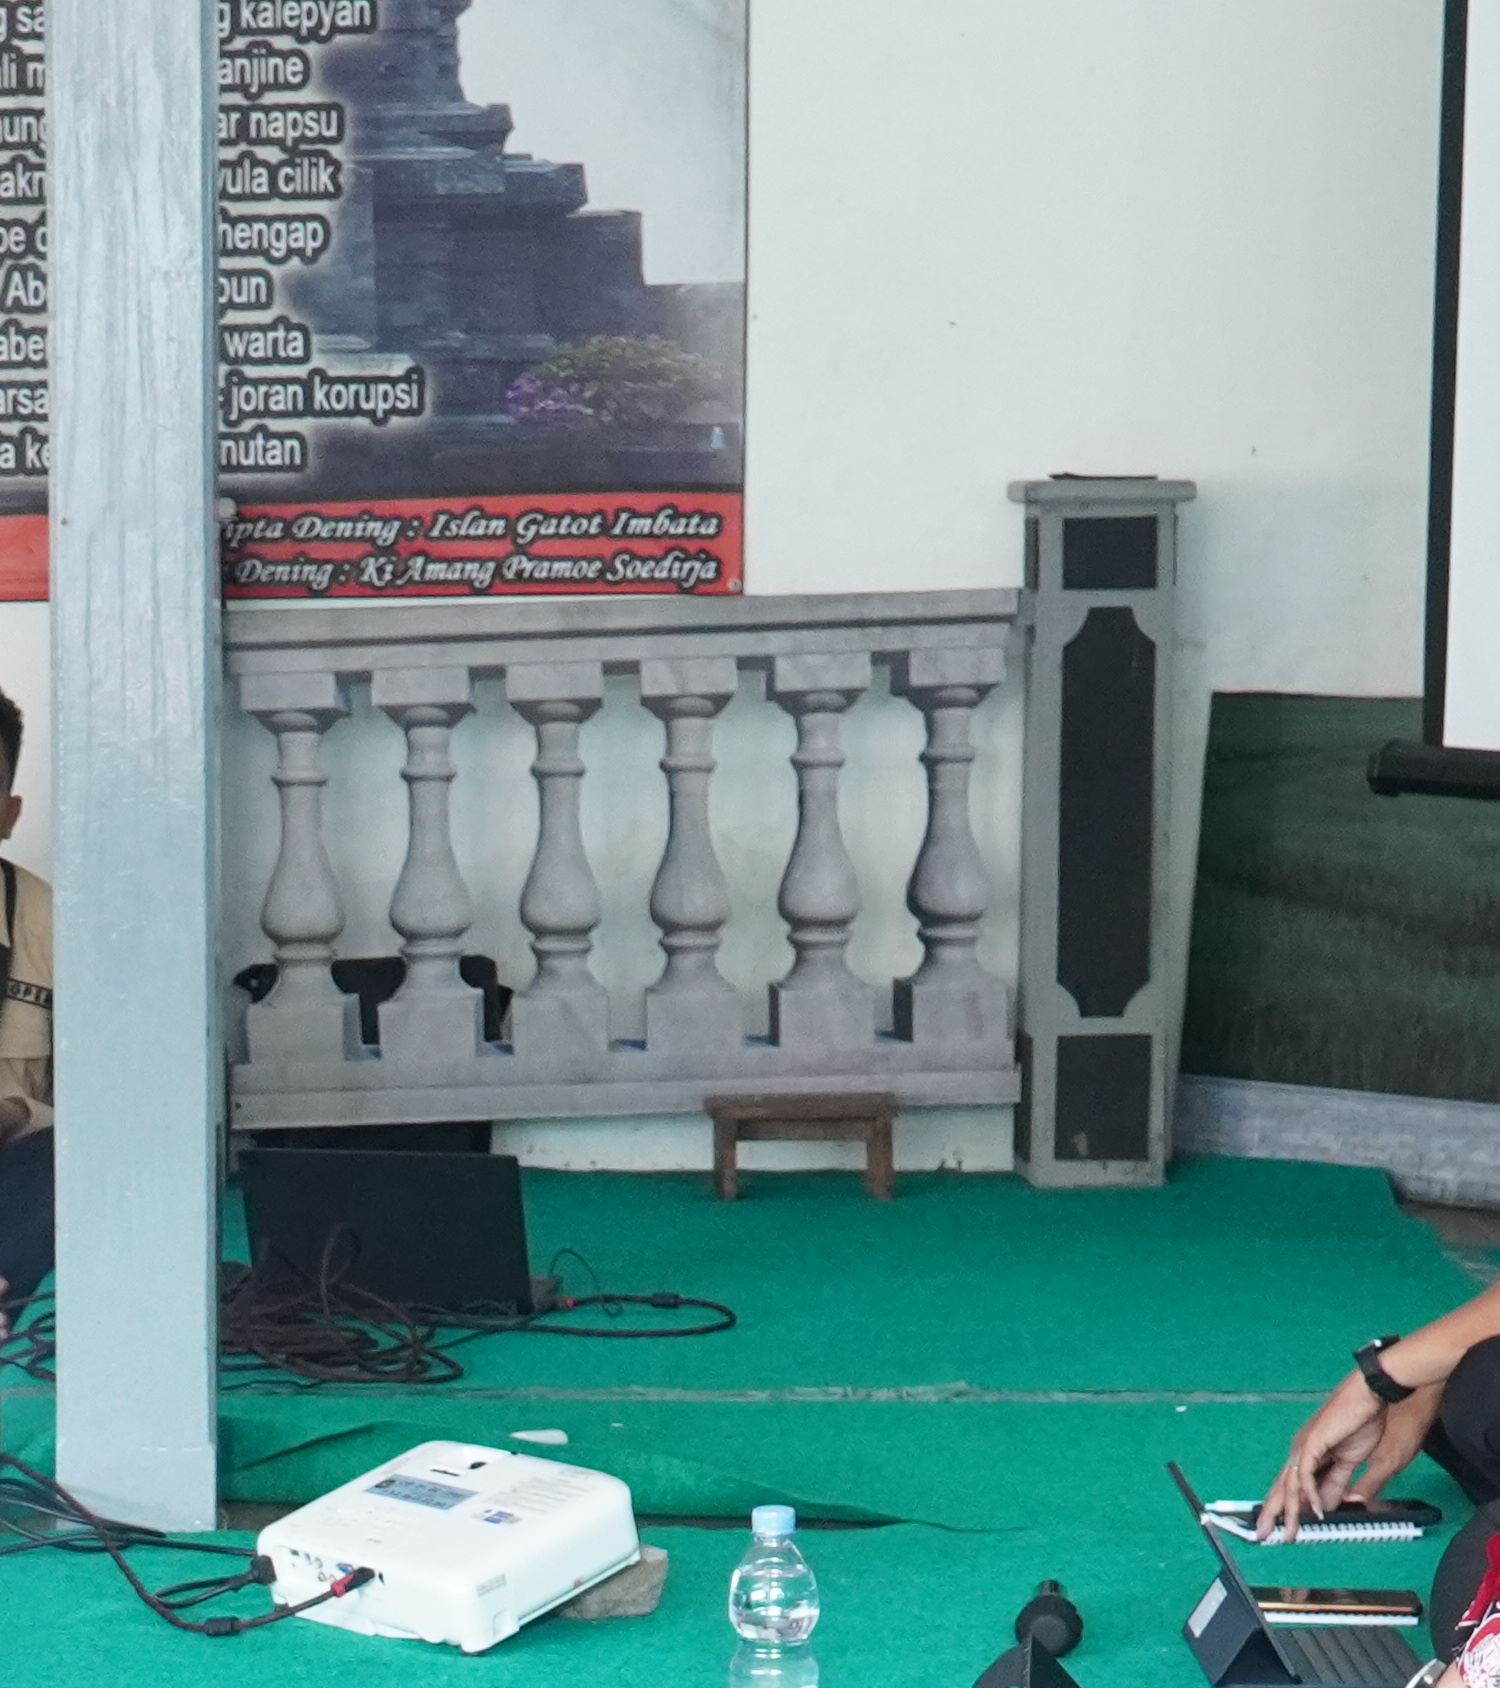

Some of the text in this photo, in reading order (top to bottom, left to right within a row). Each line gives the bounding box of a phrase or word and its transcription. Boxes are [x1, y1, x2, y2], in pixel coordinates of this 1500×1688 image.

[241, 0, 372, 41] kalepyan
[250, 107, 337, 147] napsu
[277, 157, 337, 195] cilik
[223, 322, 304, 358] warta
[229, 374, 419, 422] joran korupsi
[291, 515, 402, 547] Dening
[430, 508, 507, 540] Islan
[516, 512, 603, 546] Gatot
[611, 506, 720, 538] Imbata
[236, 556, 333, 590] Dening
[359, 554, 395, 586] Ki
[401, 555, 497, 591] Amang
[503, 550, 601, 582] Pramoe
[606, 549, 720, 592] Soedirja
